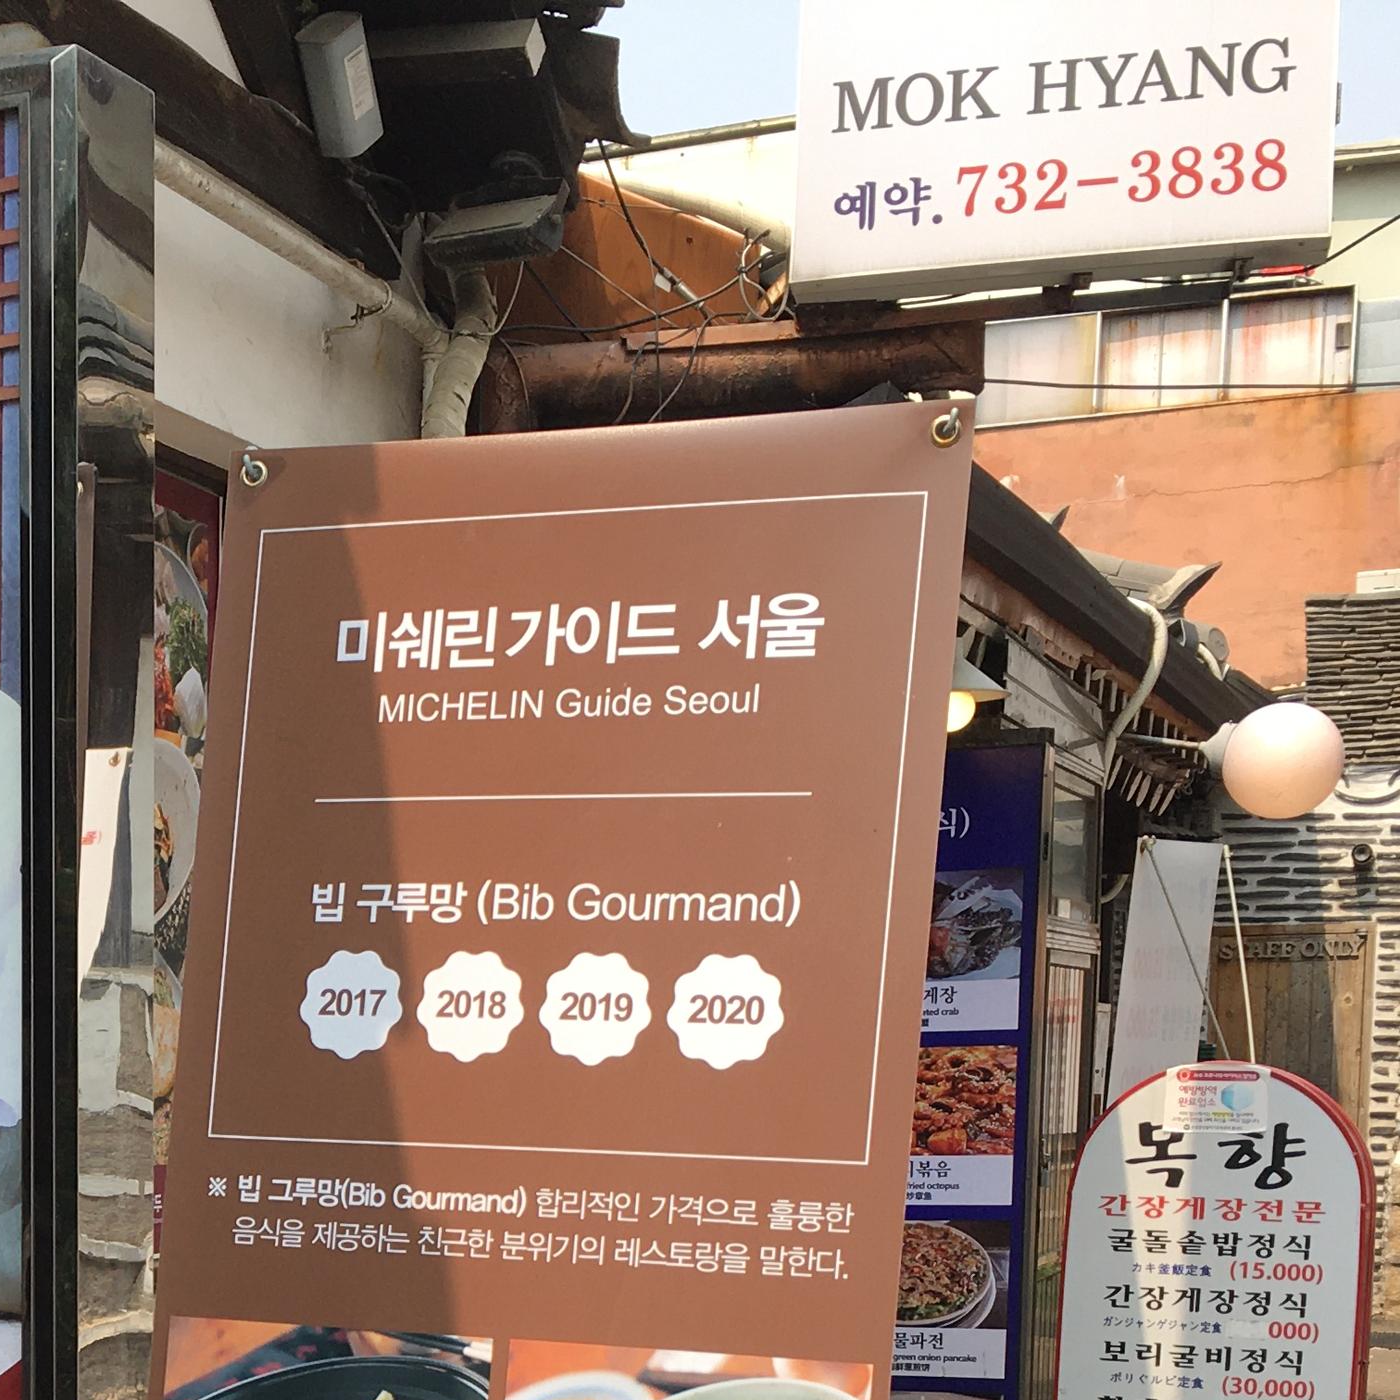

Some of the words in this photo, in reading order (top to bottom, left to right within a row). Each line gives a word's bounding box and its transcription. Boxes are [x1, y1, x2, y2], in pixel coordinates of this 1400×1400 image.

[831, 65, 1000, 134] MOK
[1027, 37, 1298, 116] HYANG
[956, 138, 1288, 217] 732-3838
[698, 592, 826, 660] 서울
[377, 689, 543, 724] MICHELIN
[555, 687, 652, 719] Guide
[663, 683, 760, 715] Seoul
[311, 881, 346, 923] 빕
[356, 881, 468, 925] 구루망
[476, 879, 555, 926] (Bib
[566, 879, 802, 928] Gourmand)
[318, 987, 388, 1018] 2017
[435, 989, 507, 1020] 2018
[559, 991, 634, 1022] 2019
[687, 994, 766, 1026] 2020
[941, 1008, 959, 1016] crab
[237, 1174, 262, 1203] 빕
[392, 1184, 527, 1218] Gourmand)
[535, 1187, 640, 1223] 합리적인
[648, 1193, 759, 1227] 가격으로
[767, 1198, 855, 1234] 훌륭한
[926, 1183, 960, 1191] octopus
[1098, 1194, 1327, 1224] 간장게장전문
[231, 1215, 306, 1249] 음식을
[311, 1221, 411, 1254] 제공하는
[417, 1225, 494, 1260] 친근한
[499, 1230, 606, 1266] 분위기의
[613, 1237, 751, 1275] 레스토랑을
[759, 1245, 849, 1280] 말한다.
[1103, 1284, 1309, 1318] 간장게장정식
[917, 1353, 942, 1362] onion
[942, 1354, 977, 1364] pancake
[1099, 1340, 1304, 1376] 보리굴비정식
